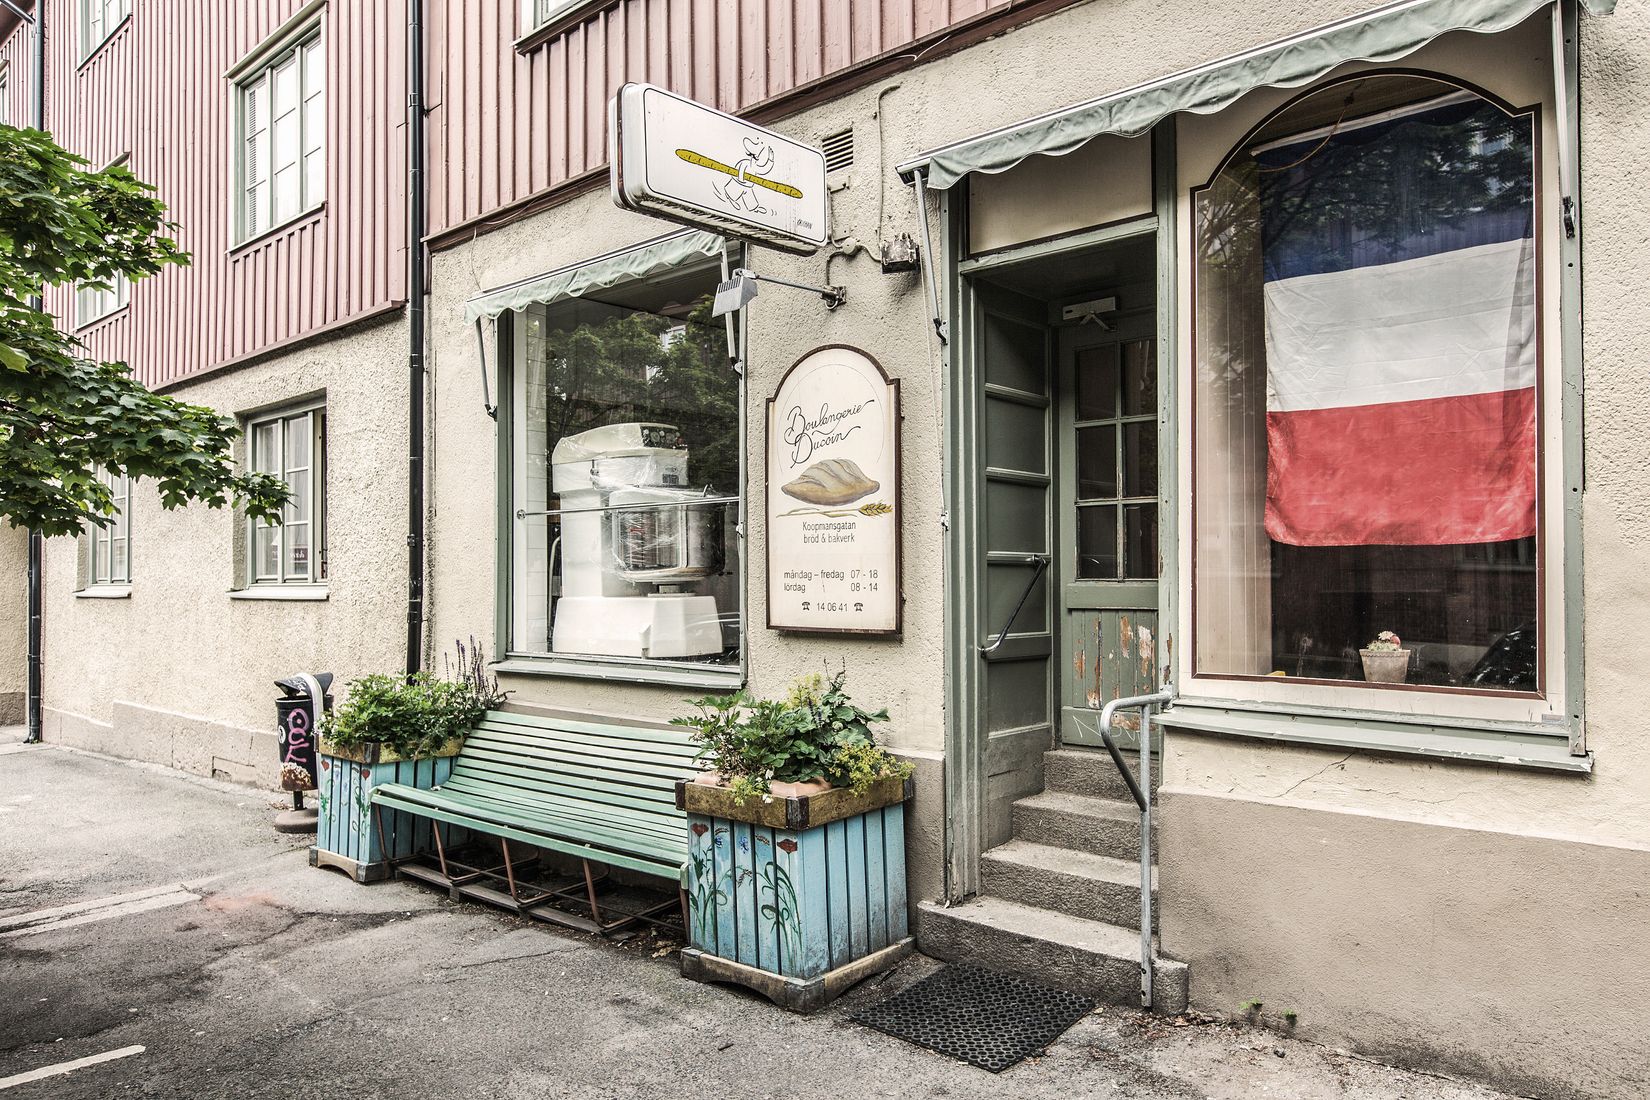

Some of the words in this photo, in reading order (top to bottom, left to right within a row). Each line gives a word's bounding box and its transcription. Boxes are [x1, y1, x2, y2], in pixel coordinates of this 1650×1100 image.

[784, 400, 875, 446] Boulangerie
[790, 425, 861, 469] Ducoin
[802, 521, 856, 533] Koopmansgatan
[803, 533, 819, 543] bröd
[821, 533, 826, 543] &
[828, 533, 855, 543] bakverk
[783, 569, 812, 581] måndag
[820, 569, 845, 581] fredag
[850, 569, 860, 579] 07
[868, 569, 878, 579] 18
[783, 582, 806, 594] lördag
[850, 582, 860, 592] 08
[868, 582, 878, 592] 14
[816, 602, 825, 611] 14
[827, 602, 837, 611] 06
[838, 602, 848, 612] 41
